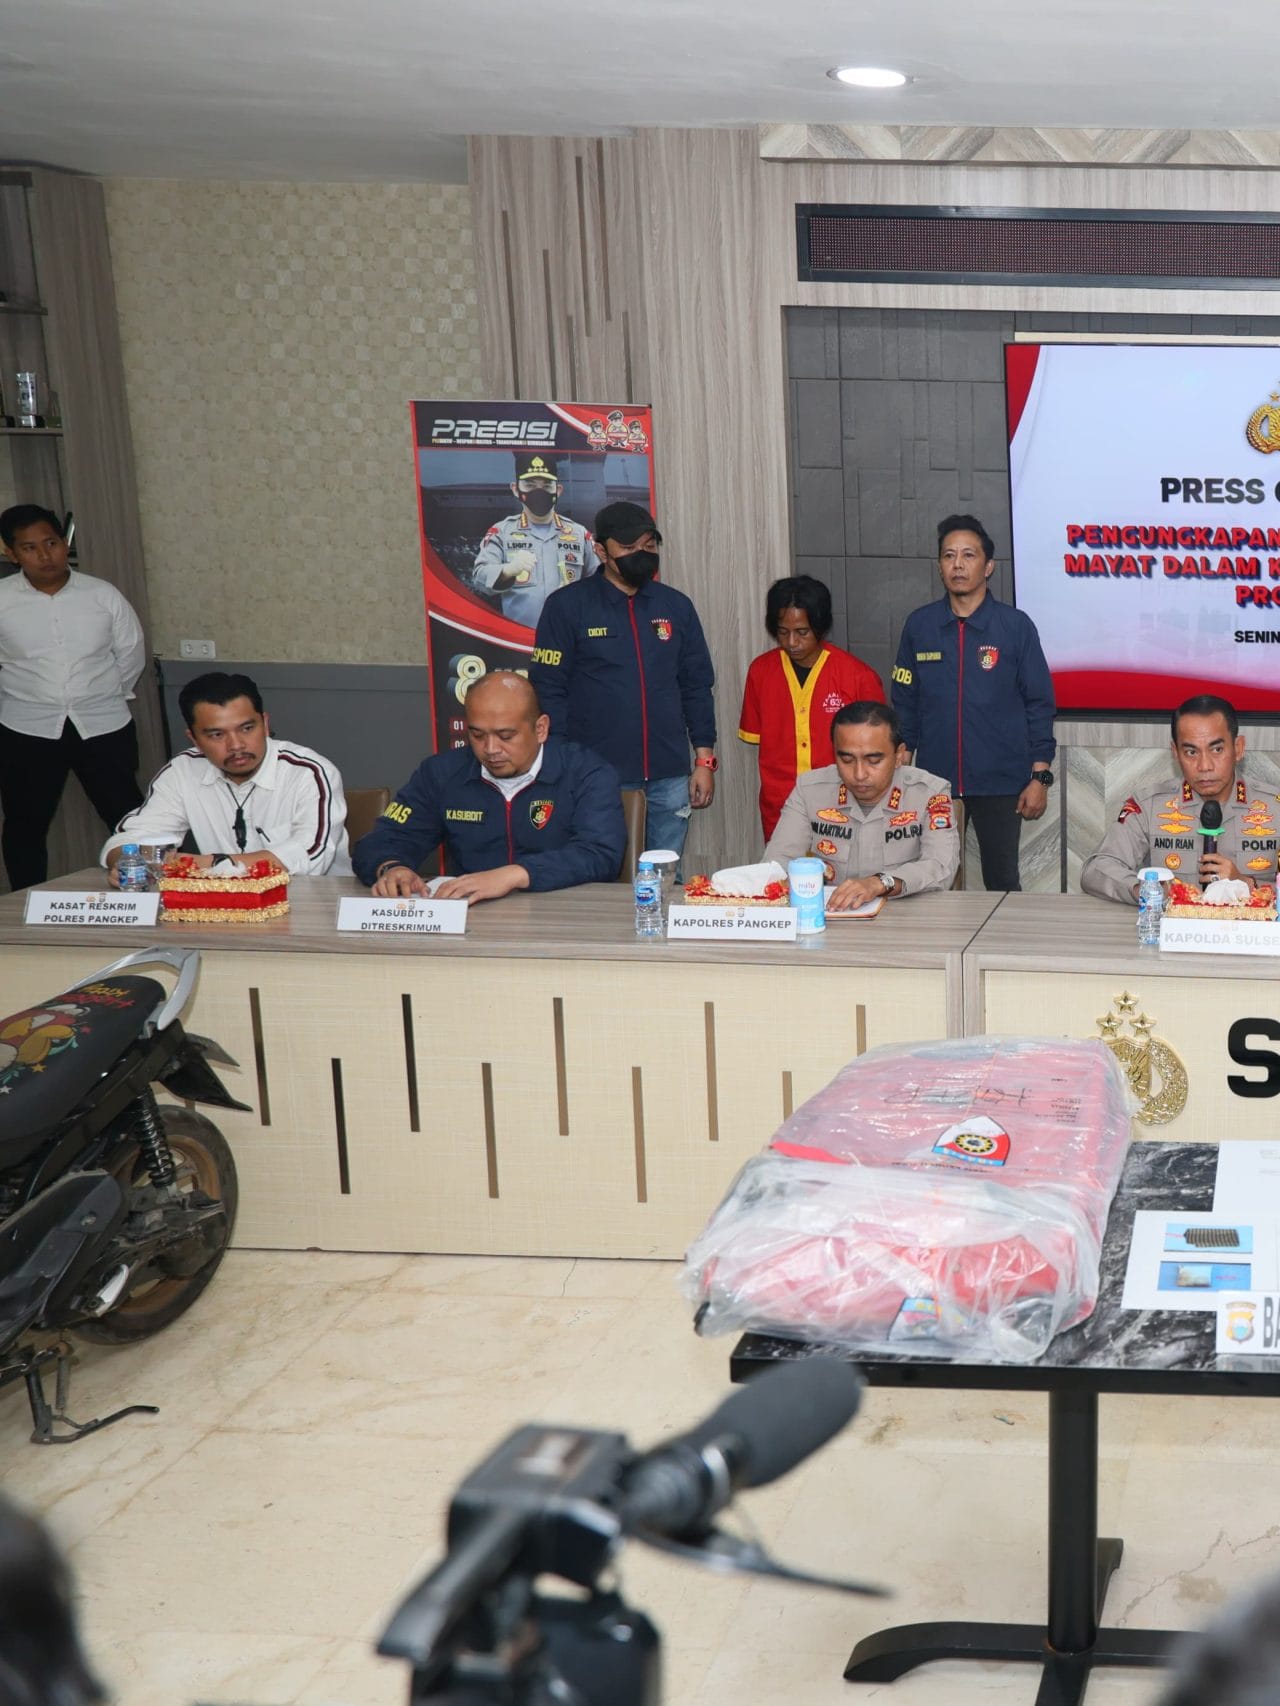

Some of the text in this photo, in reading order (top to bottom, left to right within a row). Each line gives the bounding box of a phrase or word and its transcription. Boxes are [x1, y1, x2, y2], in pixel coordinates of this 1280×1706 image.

[432, 419, 558, 440] PRESISI
[1161, 477, 1265, 505] PRESS
[1064, 553, 1156, 578] MAYAT
[1162, 555, 1260, 580] DALAM
[454, 720, 464, 730] 01
[885, 824, 923, 843] POLRI
[1154, 837, 1194, 850] ANDI RIAN
[1242, 839, 1277, 851] POLRI
[50, 902, 137, 911] KASAT RESKRIM
[44, 914, 139, 924] POLRES PANGKEP
[371, 909, 434, 918] KASUBDIT 3
[361, 922, 441, 932] DITRESKRIMUM
[673, 917, 792, 929] KAPOLRES PANGKEP
[1163, 932, 1231, 946] KAPOLDA
